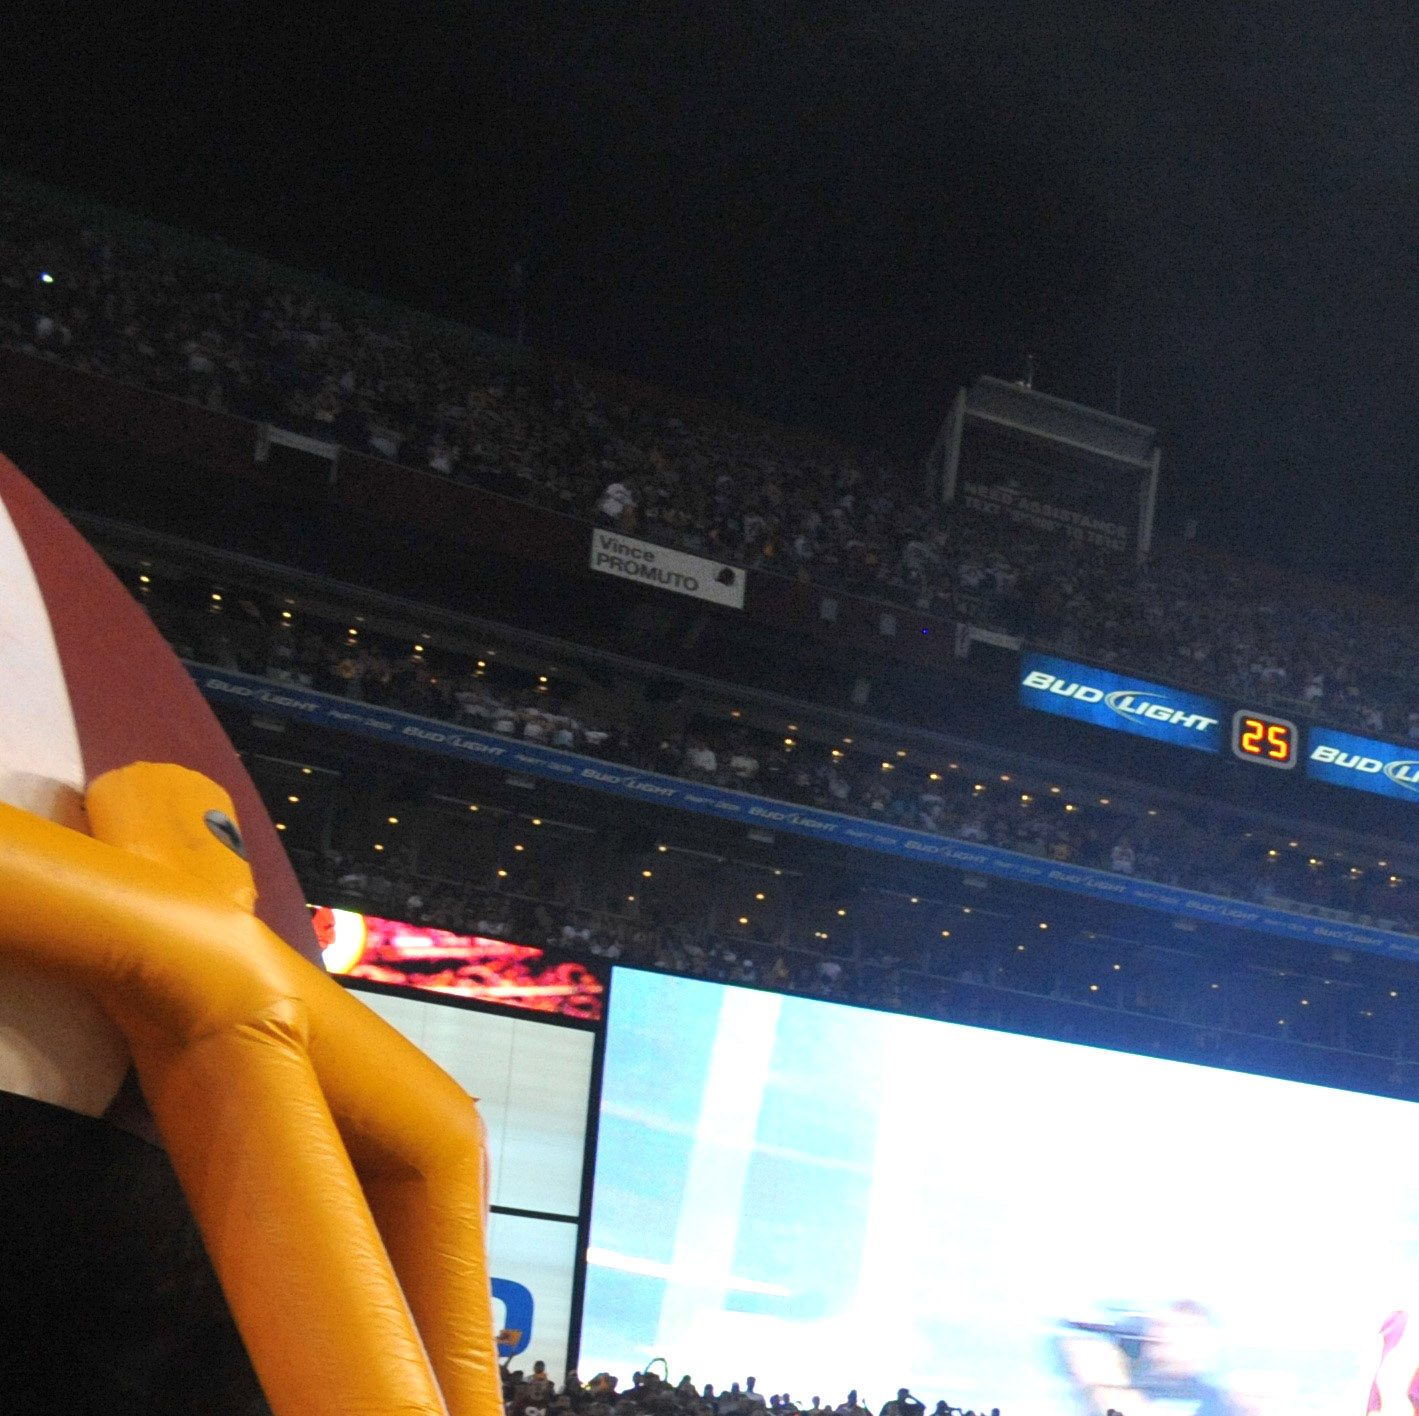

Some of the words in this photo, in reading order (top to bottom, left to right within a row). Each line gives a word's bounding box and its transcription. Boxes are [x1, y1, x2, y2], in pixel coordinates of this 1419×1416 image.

[599, 535, 655, 562] Vince
[597, 552, 699, 591] PROMUTO
[1240, 718, 1289, 760] 25
